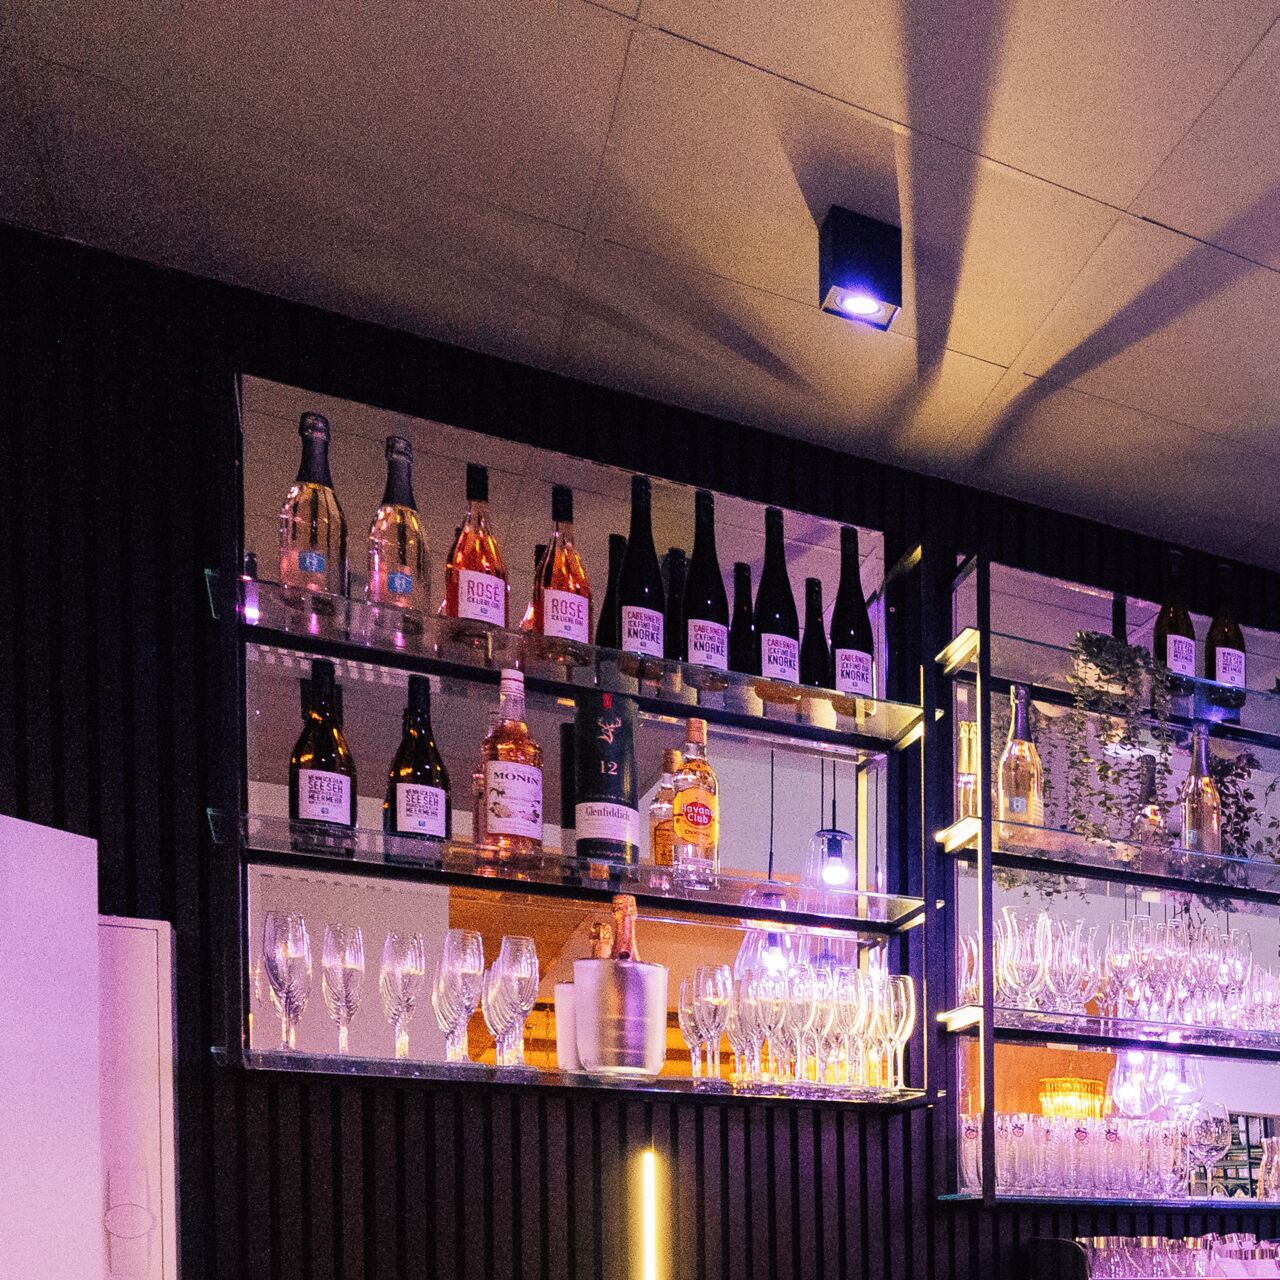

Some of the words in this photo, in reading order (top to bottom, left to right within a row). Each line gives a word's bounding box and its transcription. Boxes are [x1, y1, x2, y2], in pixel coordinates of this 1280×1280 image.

[467, 579, 500, 603] ROSÉ
[551, 598, 584, 620] ROSÉ
[627, 628, 661, 645] KNORKE
[693, 641, 725, 657] KNORKE
[767, 655, 797, 671] KNORKE
[841, 669, 869, 684] KNORKE
[600, 760, 618, 776] 12
[308, 780, 324, 791] SEE
[326, 782, 342, 793] SEH
[494, 771, 539, 786] MONIN
[406, 793, 422, 804] SEE
[423, 795, 439, 807] SEH
[585, 805, 630, 821] Glenfiddich
[687, 812, 709, 824] Club
